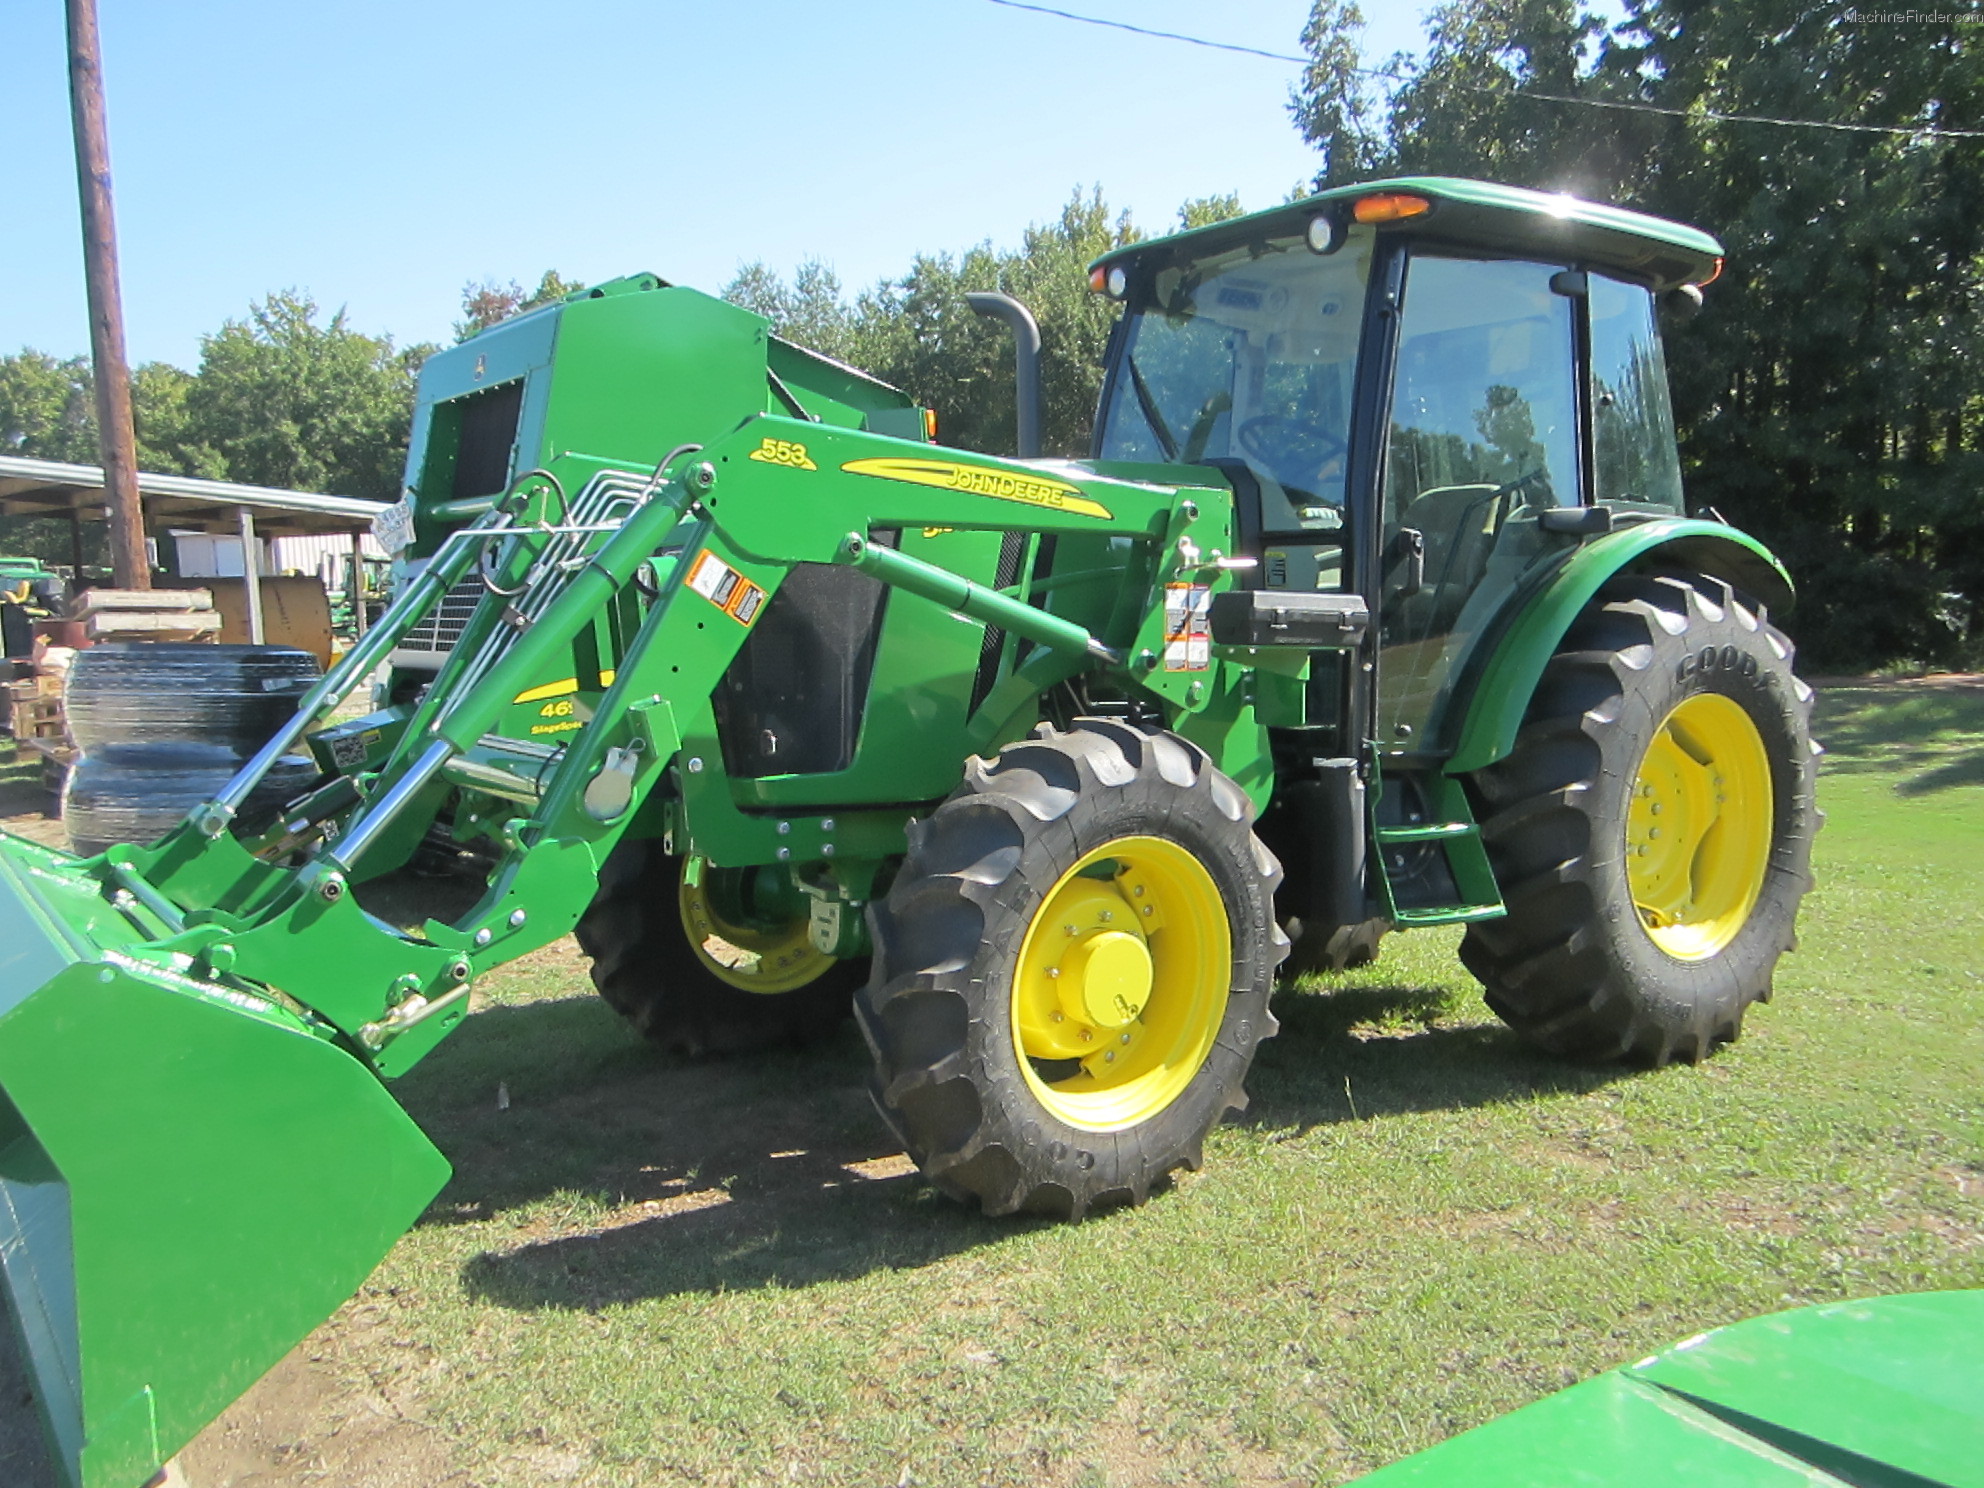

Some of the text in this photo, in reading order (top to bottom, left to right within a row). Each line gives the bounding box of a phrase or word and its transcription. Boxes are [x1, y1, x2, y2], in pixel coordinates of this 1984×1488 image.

[761, 437, 808, 466] 553
[946, 466, 1064, 506] JOHN DEERE
